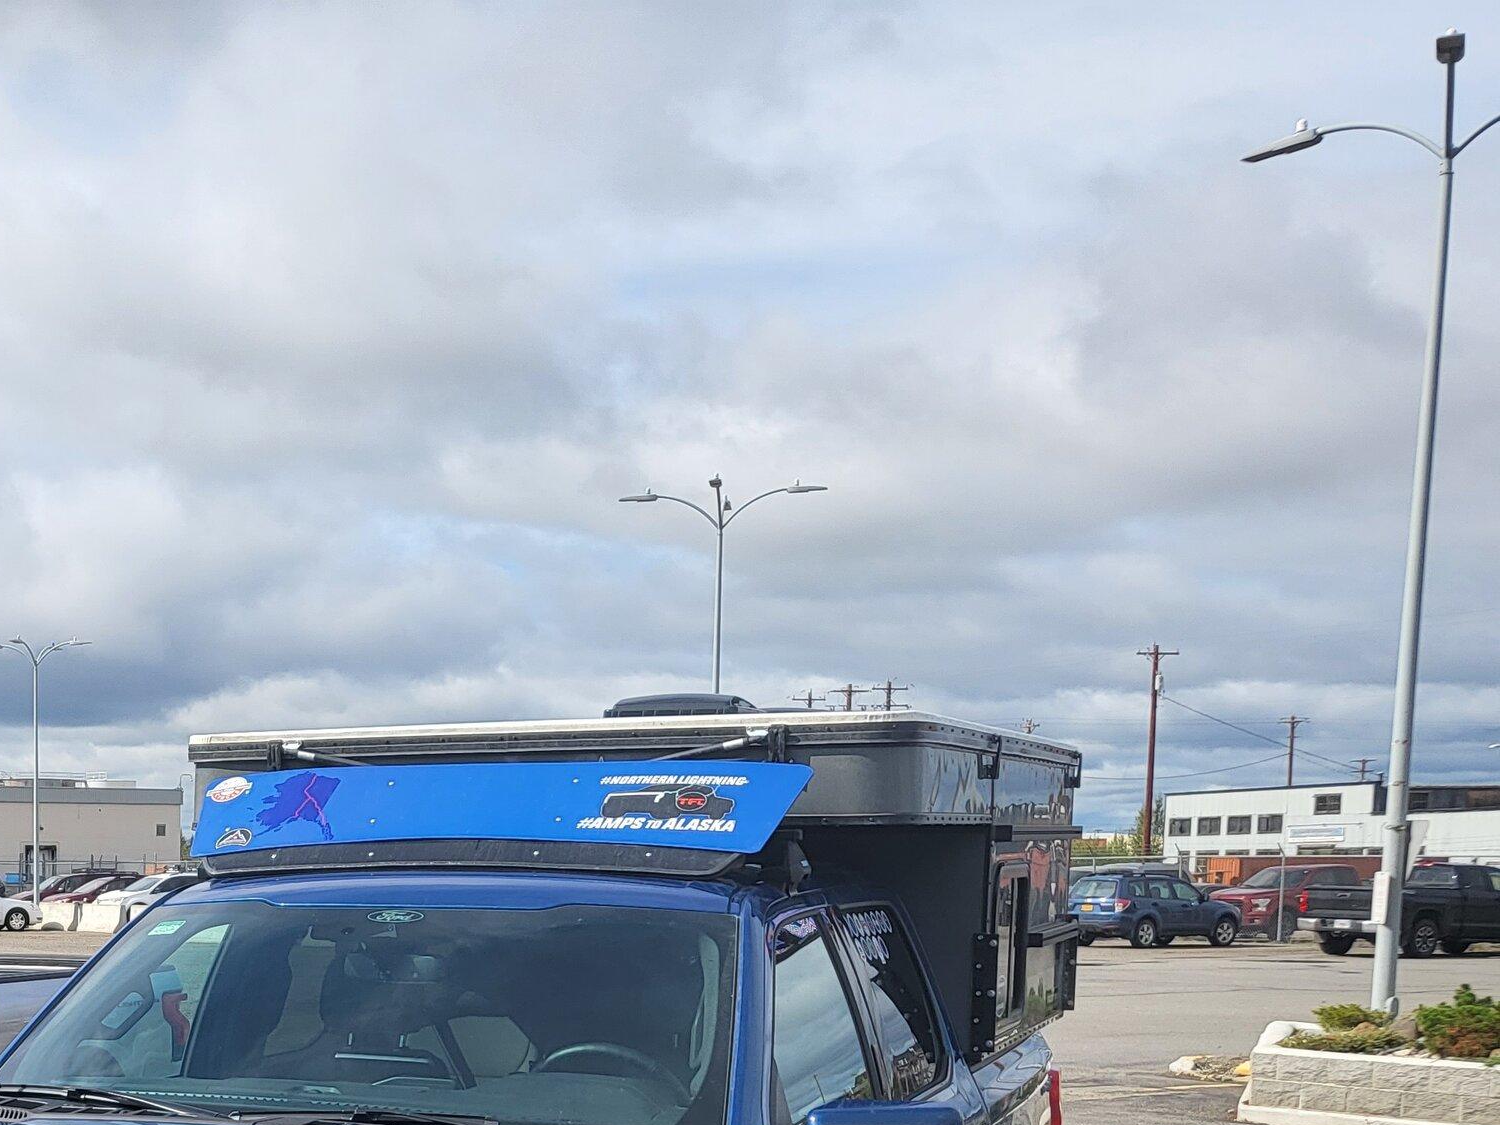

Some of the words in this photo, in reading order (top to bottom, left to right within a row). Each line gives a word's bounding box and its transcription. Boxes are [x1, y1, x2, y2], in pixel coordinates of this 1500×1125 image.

[600, 775, 678, 785] #NORTHERN
[576, 817, 646, 830] #AMPS
[661, 818, 737, 832] ALASKA
[376, 911, 416, 921] Ford
